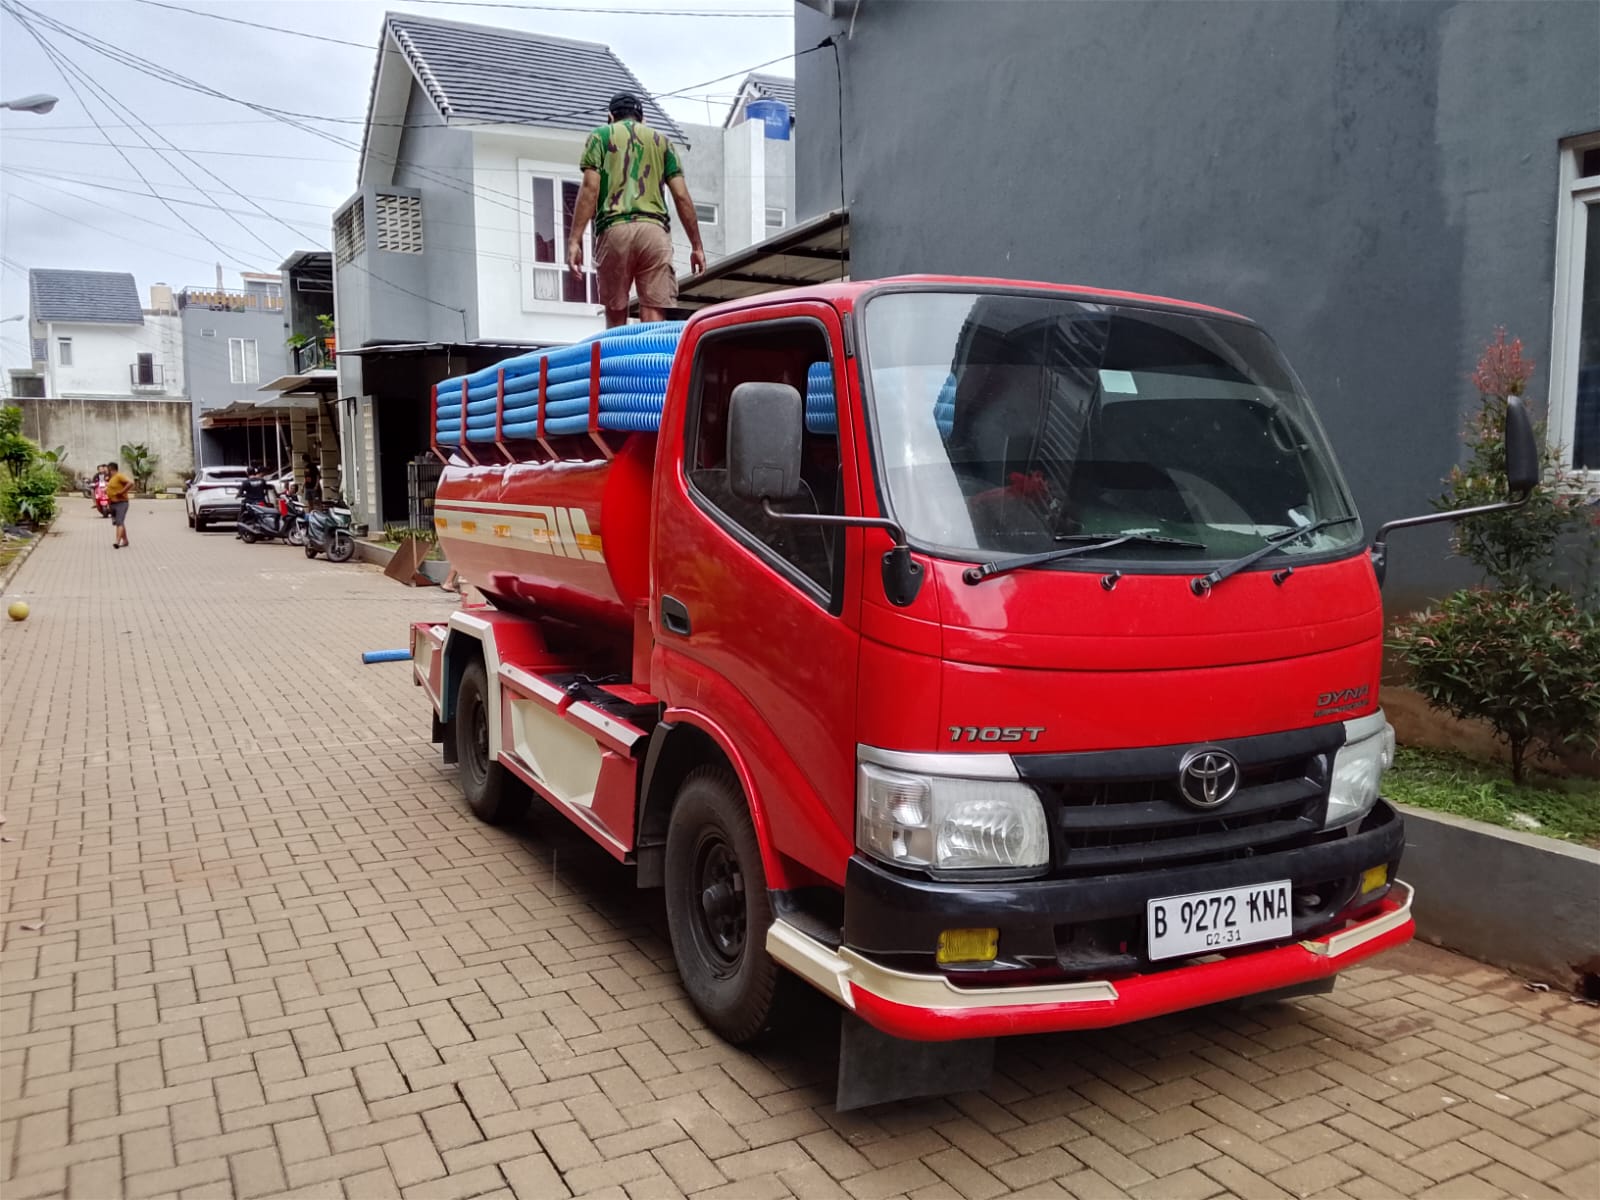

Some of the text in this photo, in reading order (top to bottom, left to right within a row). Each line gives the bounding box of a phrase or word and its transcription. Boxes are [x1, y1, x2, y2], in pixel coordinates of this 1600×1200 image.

[948, 726, 1046, 742] 110ST
[1154, 887, 1288, 939] B 9272 KNA
